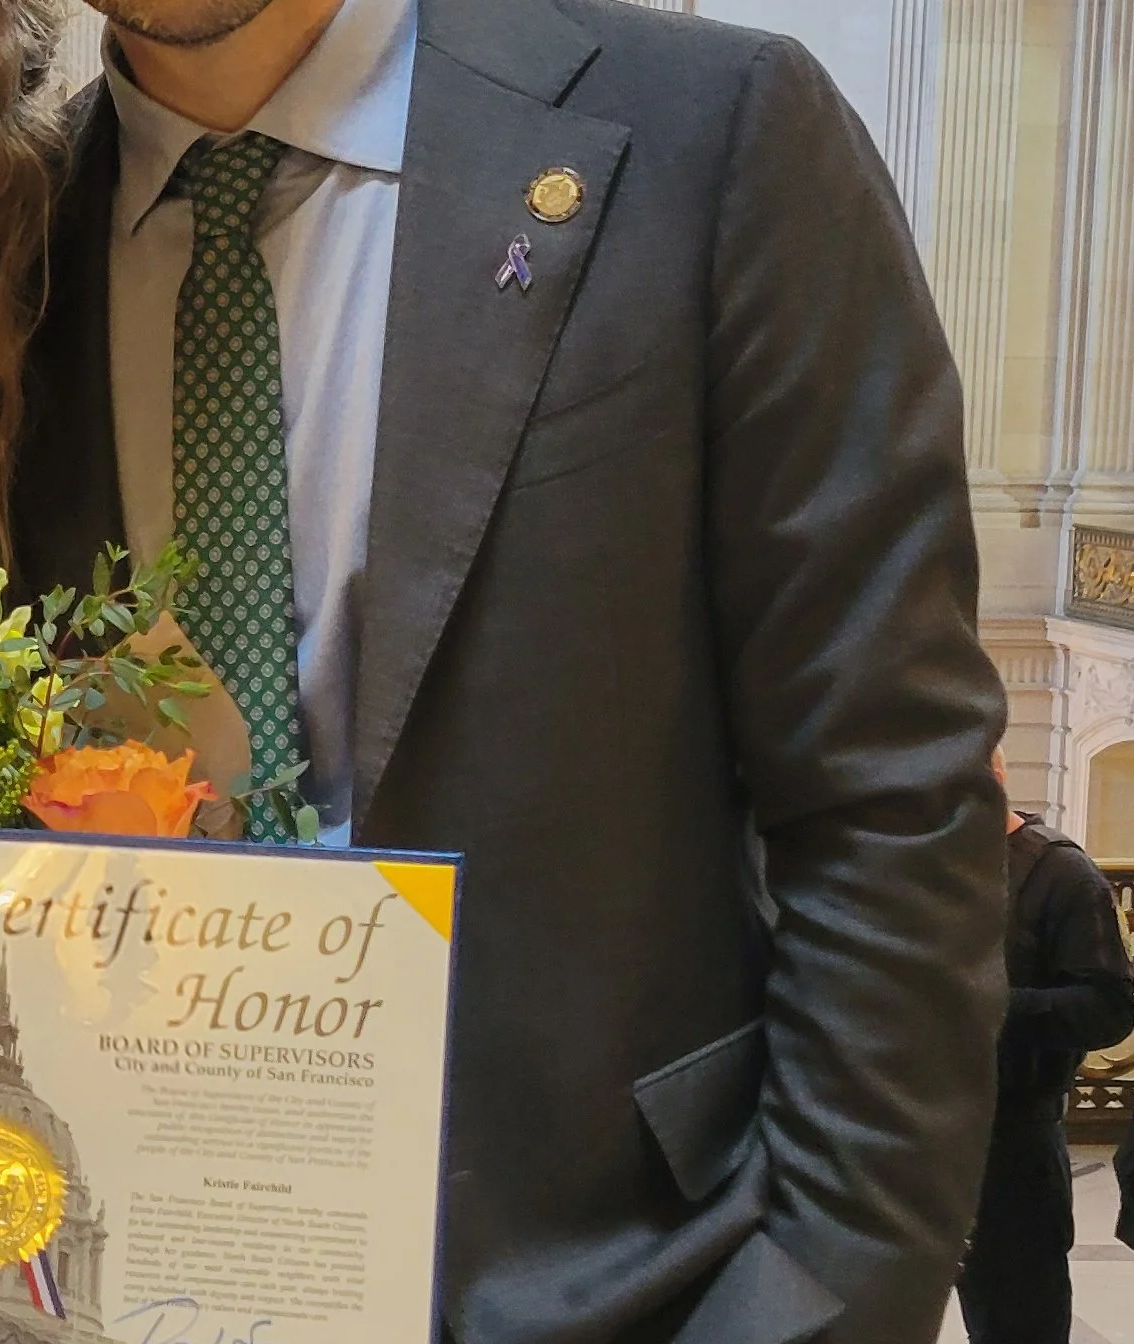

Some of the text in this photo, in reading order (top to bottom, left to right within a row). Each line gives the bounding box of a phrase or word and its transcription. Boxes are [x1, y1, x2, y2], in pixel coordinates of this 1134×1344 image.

[317, 893, 398, 984] of
[167, 965, 384, 1040] Honor
[99, 1033, 374, 1070] BOARD OF SUPERVISORS
[114, 1056, 374, 1087] City and County of San Francisco
